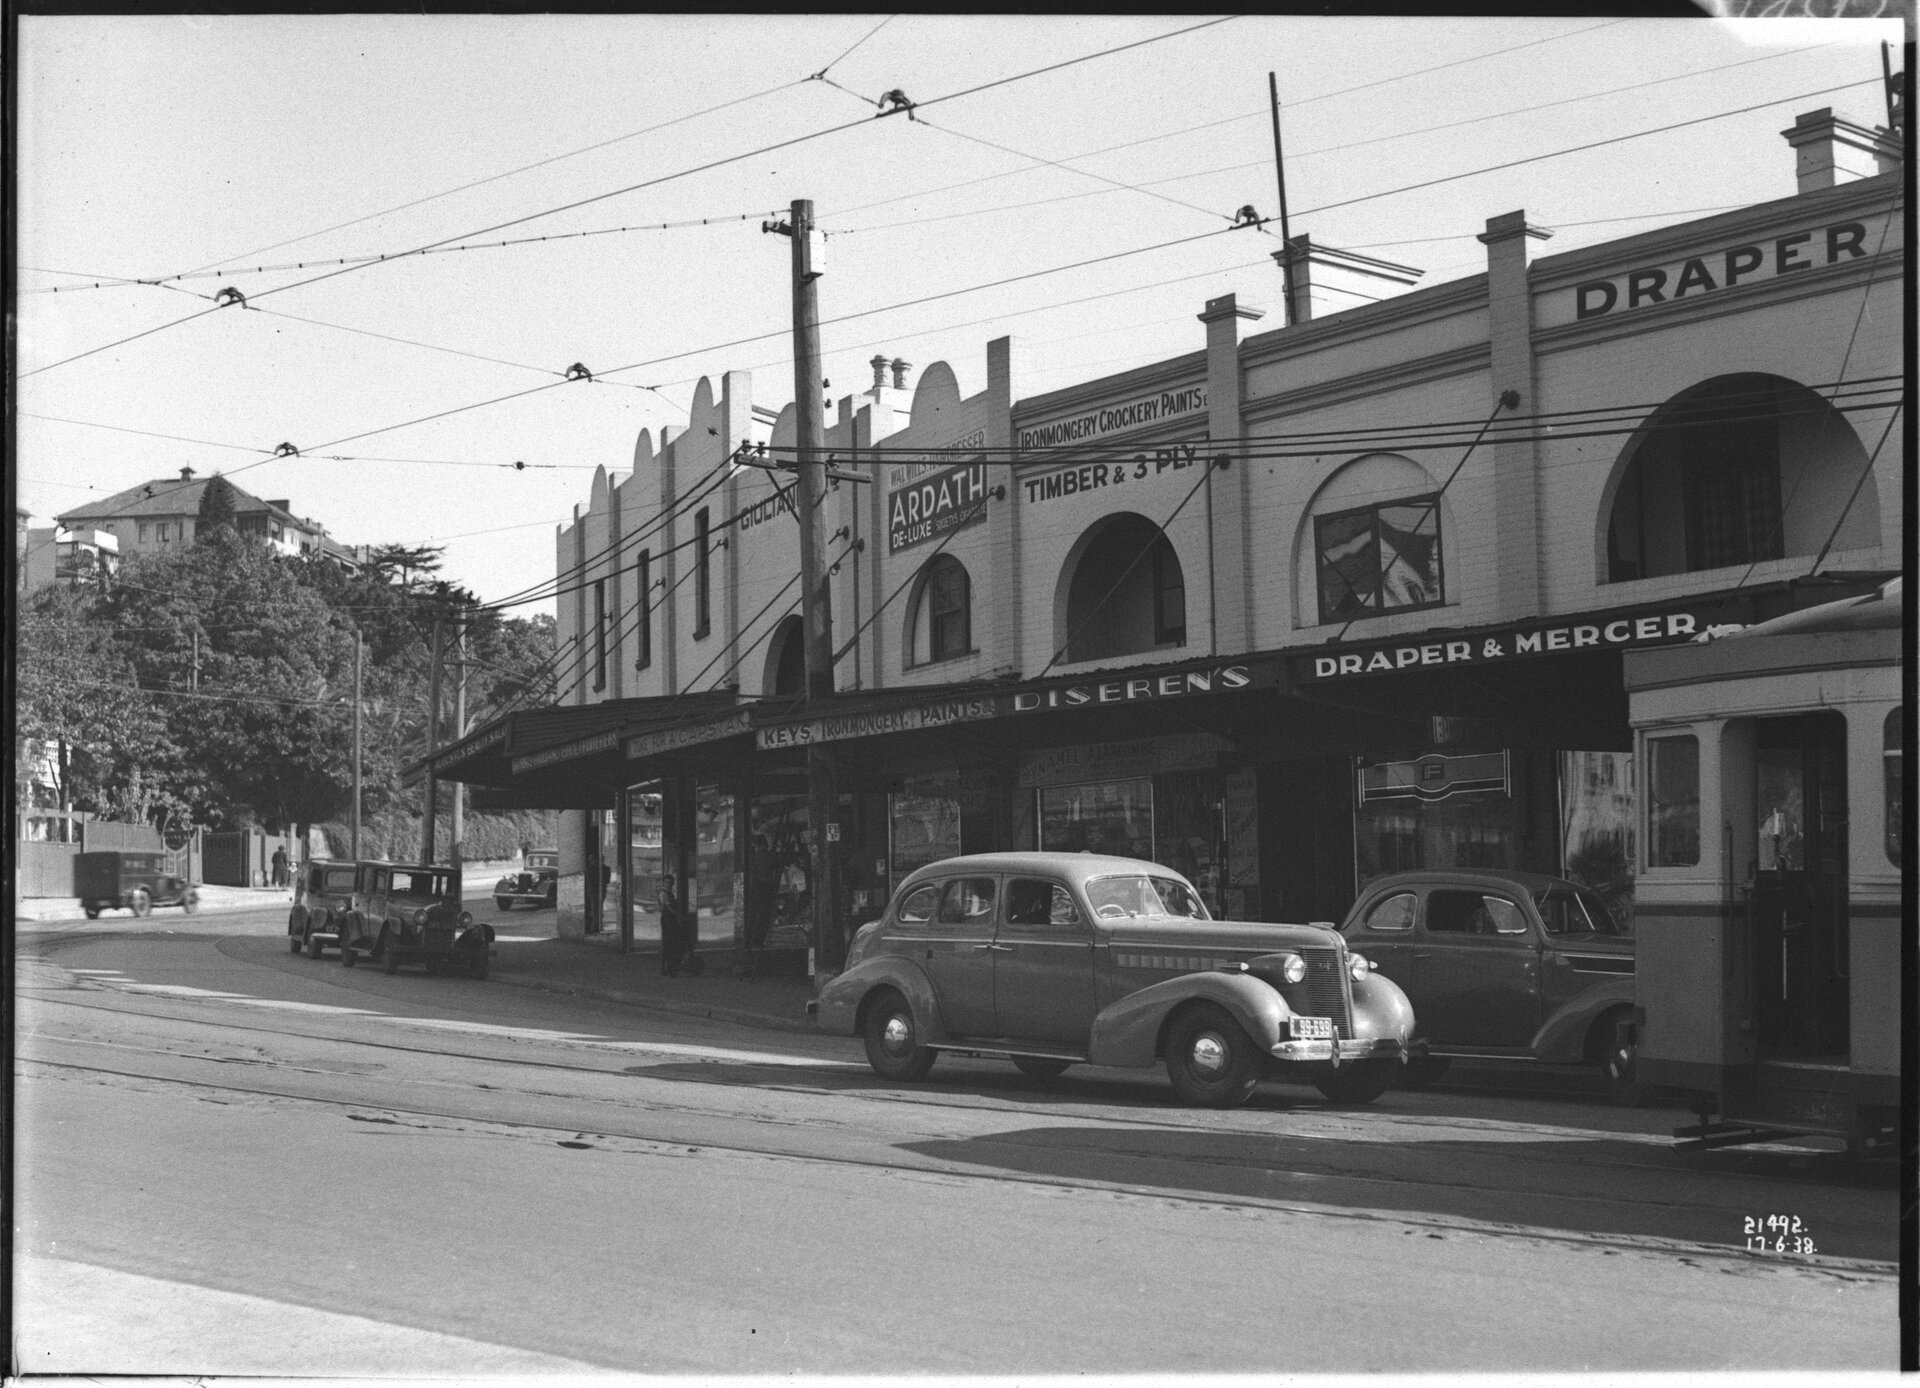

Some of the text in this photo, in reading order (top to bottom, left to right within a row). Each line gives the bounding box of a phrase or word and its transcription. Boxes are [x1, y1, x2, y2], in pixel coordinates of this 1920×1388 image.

[1576, 222, 1868, 320] DRAPER
[1021, 414, 1098, 452] IRONMONGERY
[1161, 387, 1201, 417] PAINTS
[891, 462, 984, 531] ARDATH
[1025, 444, 1196, 503] TIMBER & 3 PLY
[740, 483, 800, 531] GIULIAN
[893, 520, 932, 548] DE-LUXE
[1315, 641, 1472, 678] DRAPER
[1483, 638, 1505, 658] &
[1515, 612, 1698, 654] MERCER
[920, 702, 983, 725] PAINTS
[1014, 665, 1250, 711] DISEREN'S
